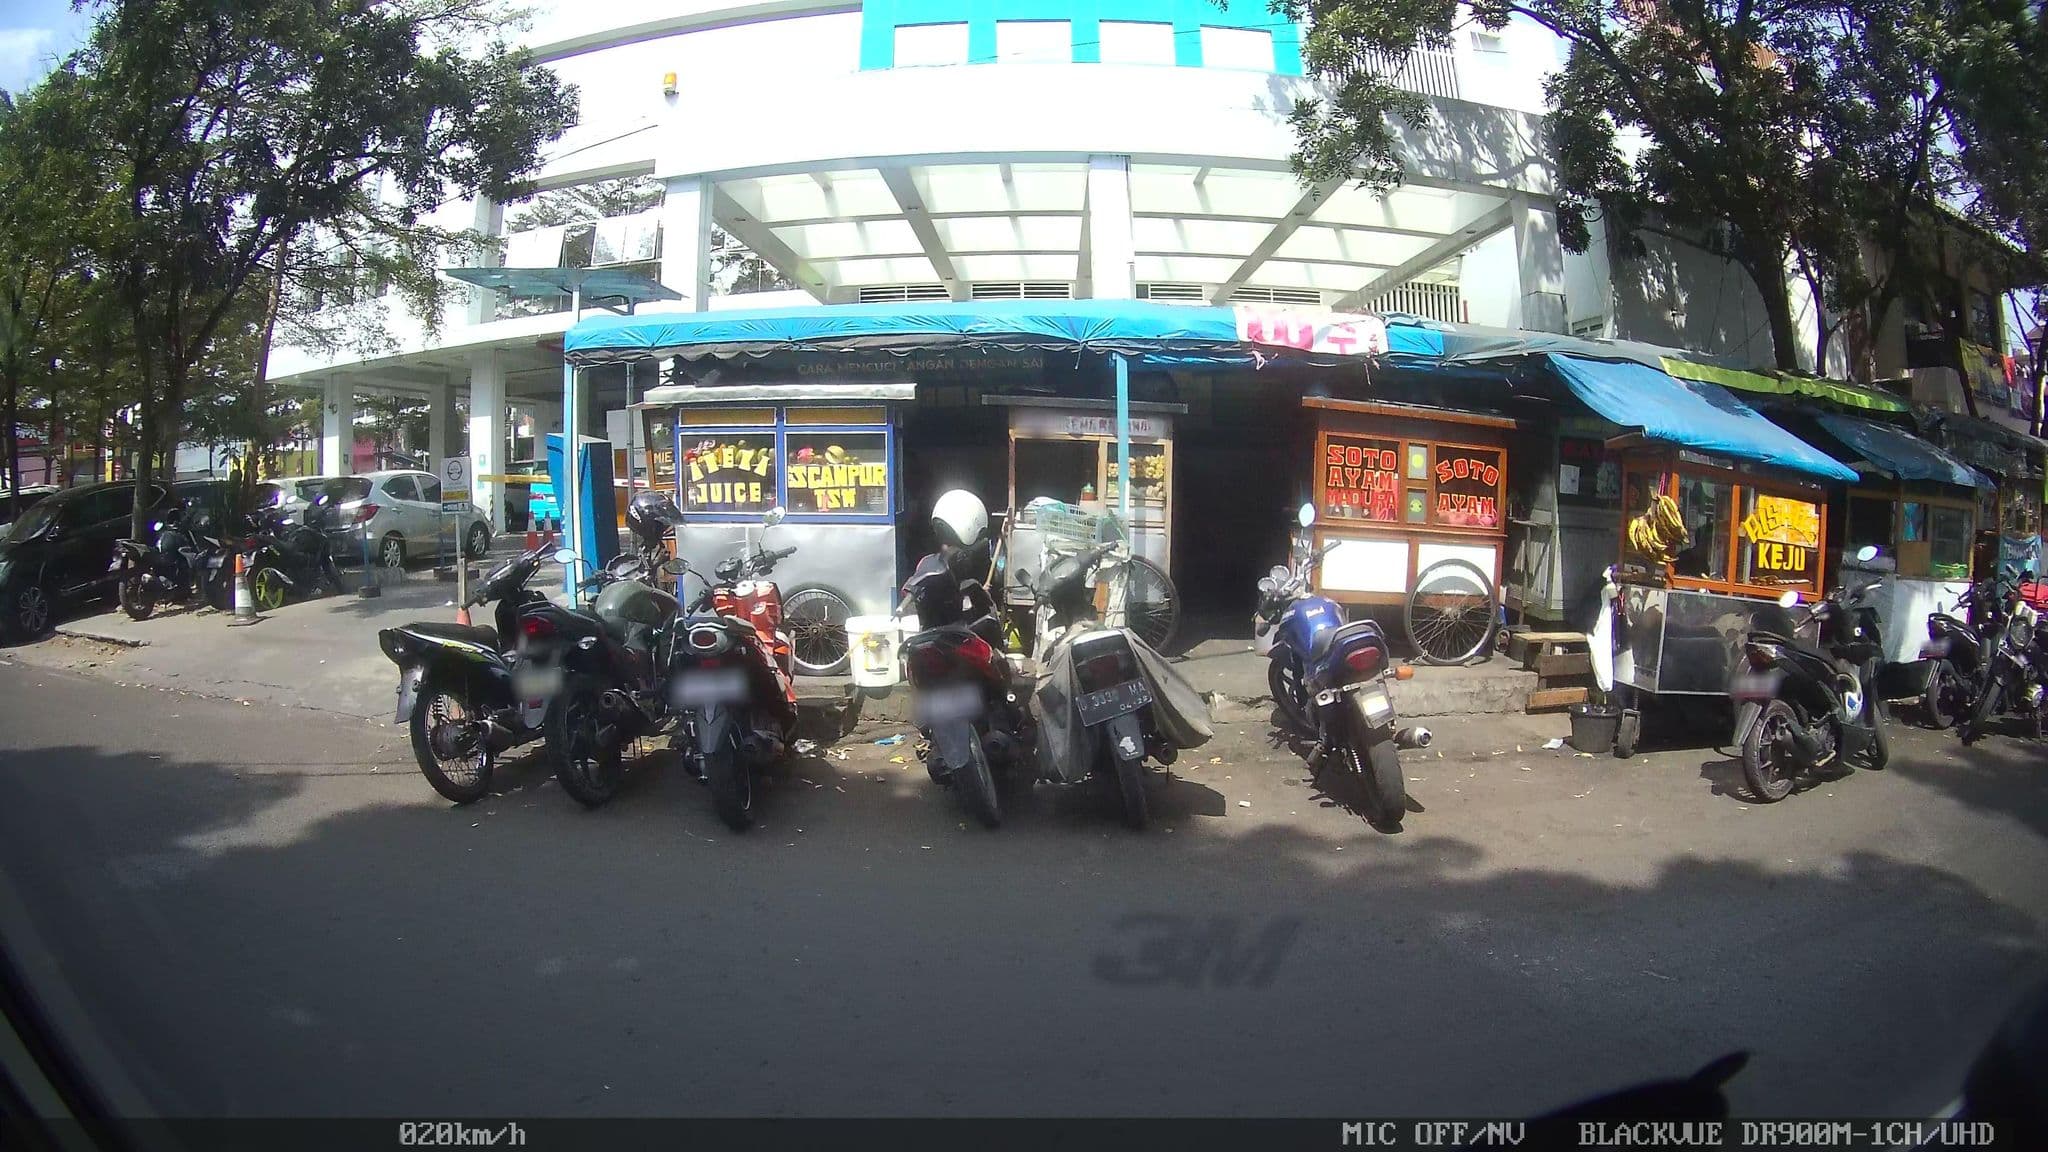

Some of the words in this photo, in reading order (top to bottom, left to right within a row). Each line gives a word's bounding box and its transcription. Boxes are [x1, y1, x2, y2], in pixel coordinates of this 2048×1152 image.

[653, 451, 673, 463] MIE
[1327, 444, 1397, 471] SOTO
[1327, 466, 1395, 492] AYAM
[1436, 458, 1499, 487] SOTO
[697, 482, 762, 503] JUICE
[1437, 493, 1495, 516] AYAM
[1758, 542, 1806, 571] KEJU
[1092, 912, 1303, 990] 3M
